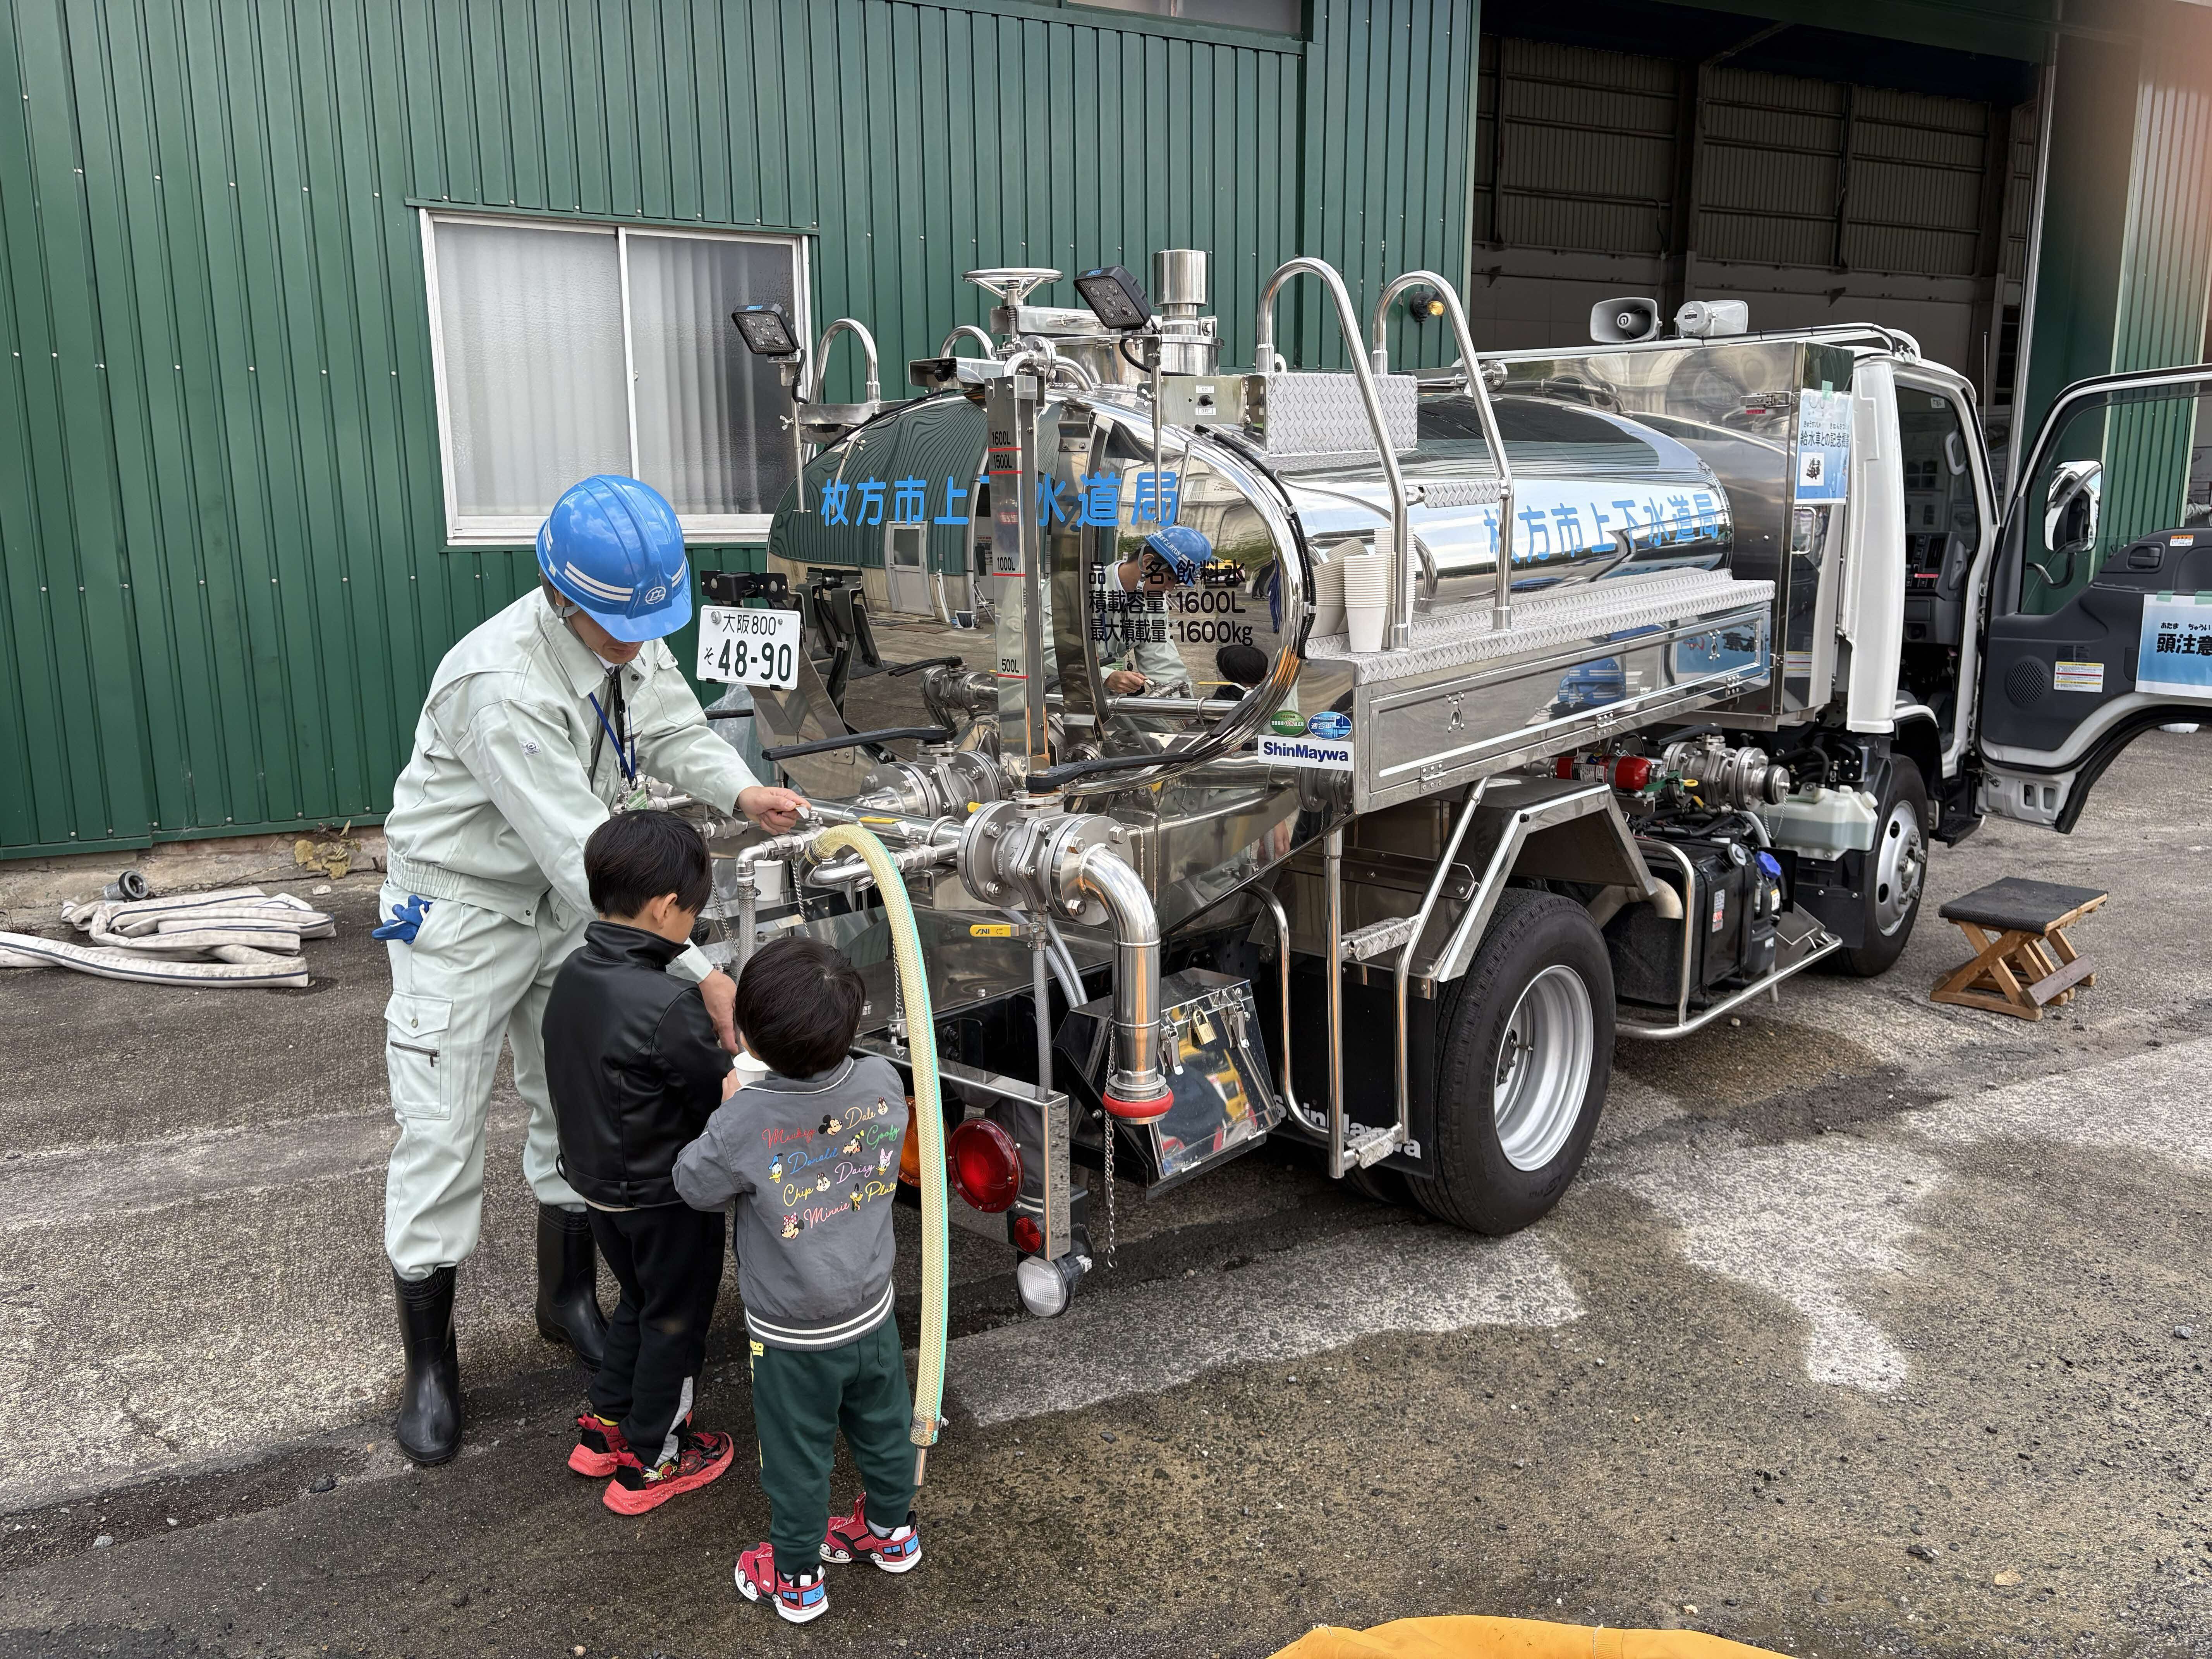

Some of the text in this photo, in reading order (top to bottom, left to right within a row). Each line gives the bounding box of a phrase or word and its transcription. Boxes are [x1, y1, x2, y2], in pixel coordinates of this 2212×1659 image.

[992, 431, 1011, 446] 1600L
[993, 454, 1012, 469] 1500L
[821, 472, 1176, 527] 枚方市上水道局
[997, 557, 1015, 572] 1000L
[704, 639, 792, 682] そ 48-90
[1002, 658, 1019, 673] 500L
[1263, 741, 1348, 763] ShinMaywa
[845, 1107, 876, 1130] Dale
[787, 1124, 900, 1175] Donald Goofy
[783, 1161, 875, 1207] Chip Daisy
[803, 1201, 850, 1229] Minnie
